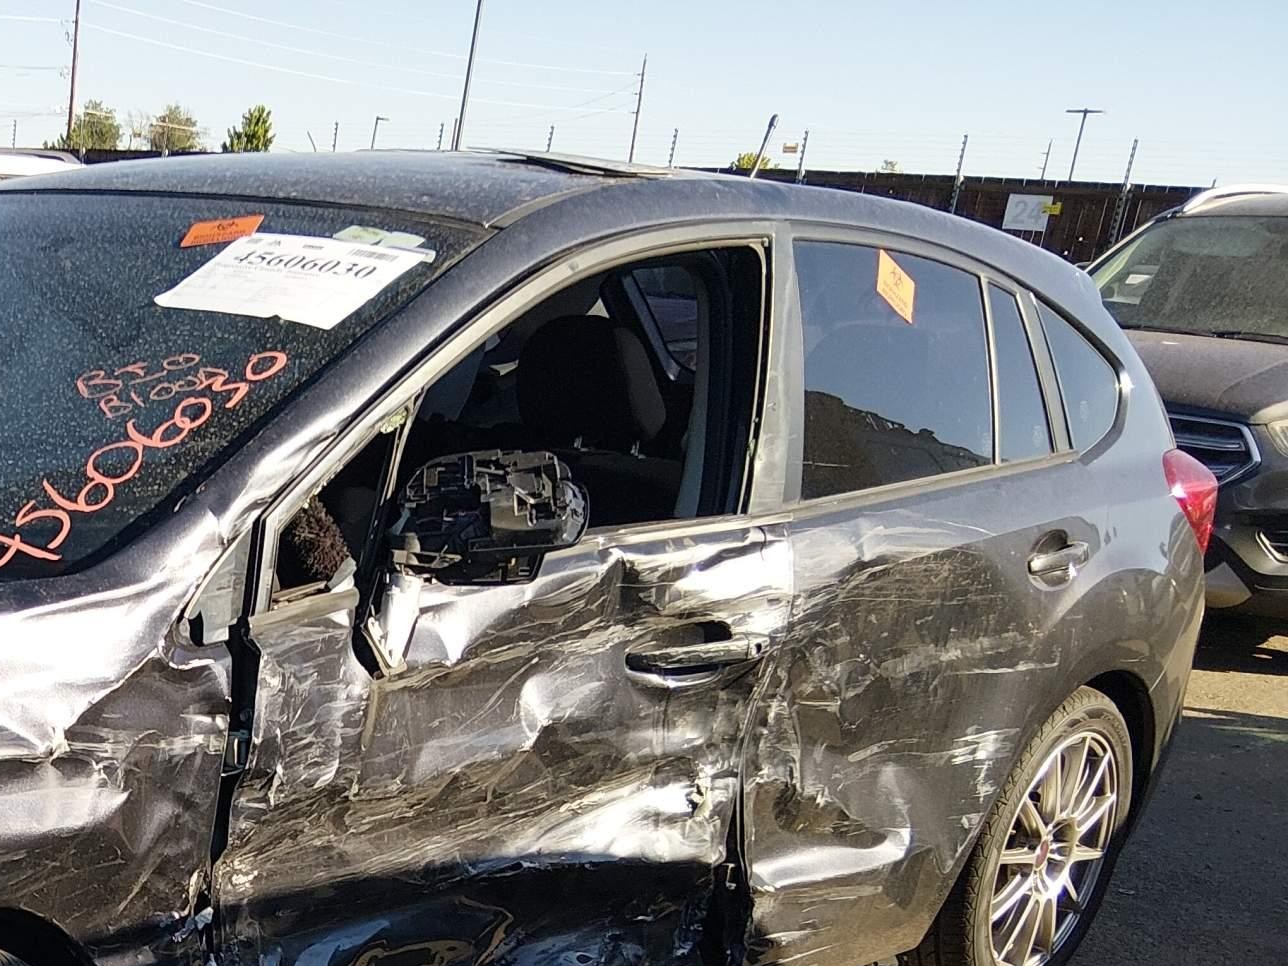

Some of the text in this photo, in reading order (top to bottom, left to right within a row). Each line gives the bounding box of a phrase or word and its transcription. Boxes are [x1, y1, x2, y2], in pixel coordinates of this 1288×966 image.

[1012, 199, 1043, 225] 24
[234, 249, 378, 279] 45606030
[77, 352, 201, 399] BIO
